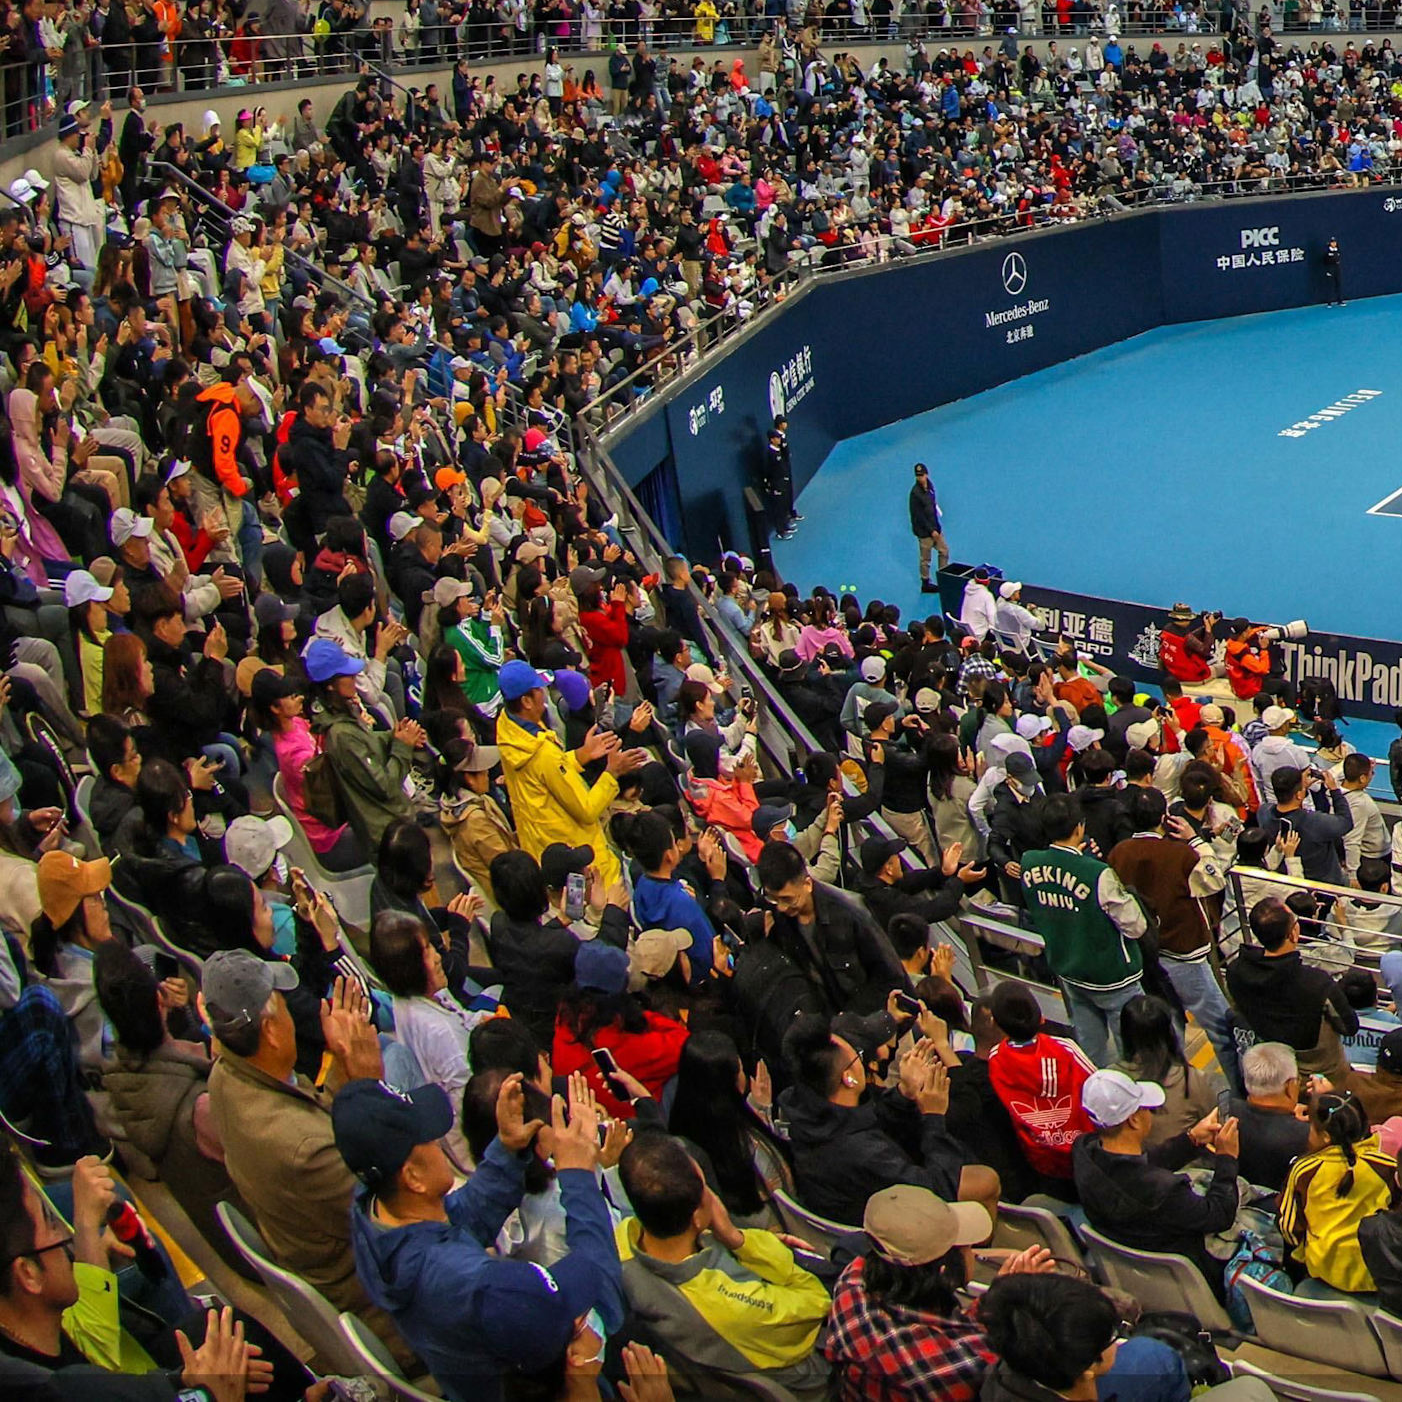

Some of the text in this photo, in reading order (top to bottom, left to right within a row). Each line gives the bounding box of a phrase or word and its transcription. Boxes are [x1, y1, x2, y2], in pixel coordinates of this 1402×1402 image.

[1240, 226, 1280, 248] PICC
[1216, 247, 1305, 270] 中国人民保险
[985, 299, 1050, 328] Mercedes-Benz
[782, 346, 812, 393] 中信银行
[1308, 389, 1383, 423] BEIJING
[220, 434, 230, 454] 9
[1037, 606, 1114, 644] 利亚德
[1074, 640, 1113, 656] ARD
[1023, 865, 1091, 900] PEKING
[1037, 890, 1079, 912] UNIV.
